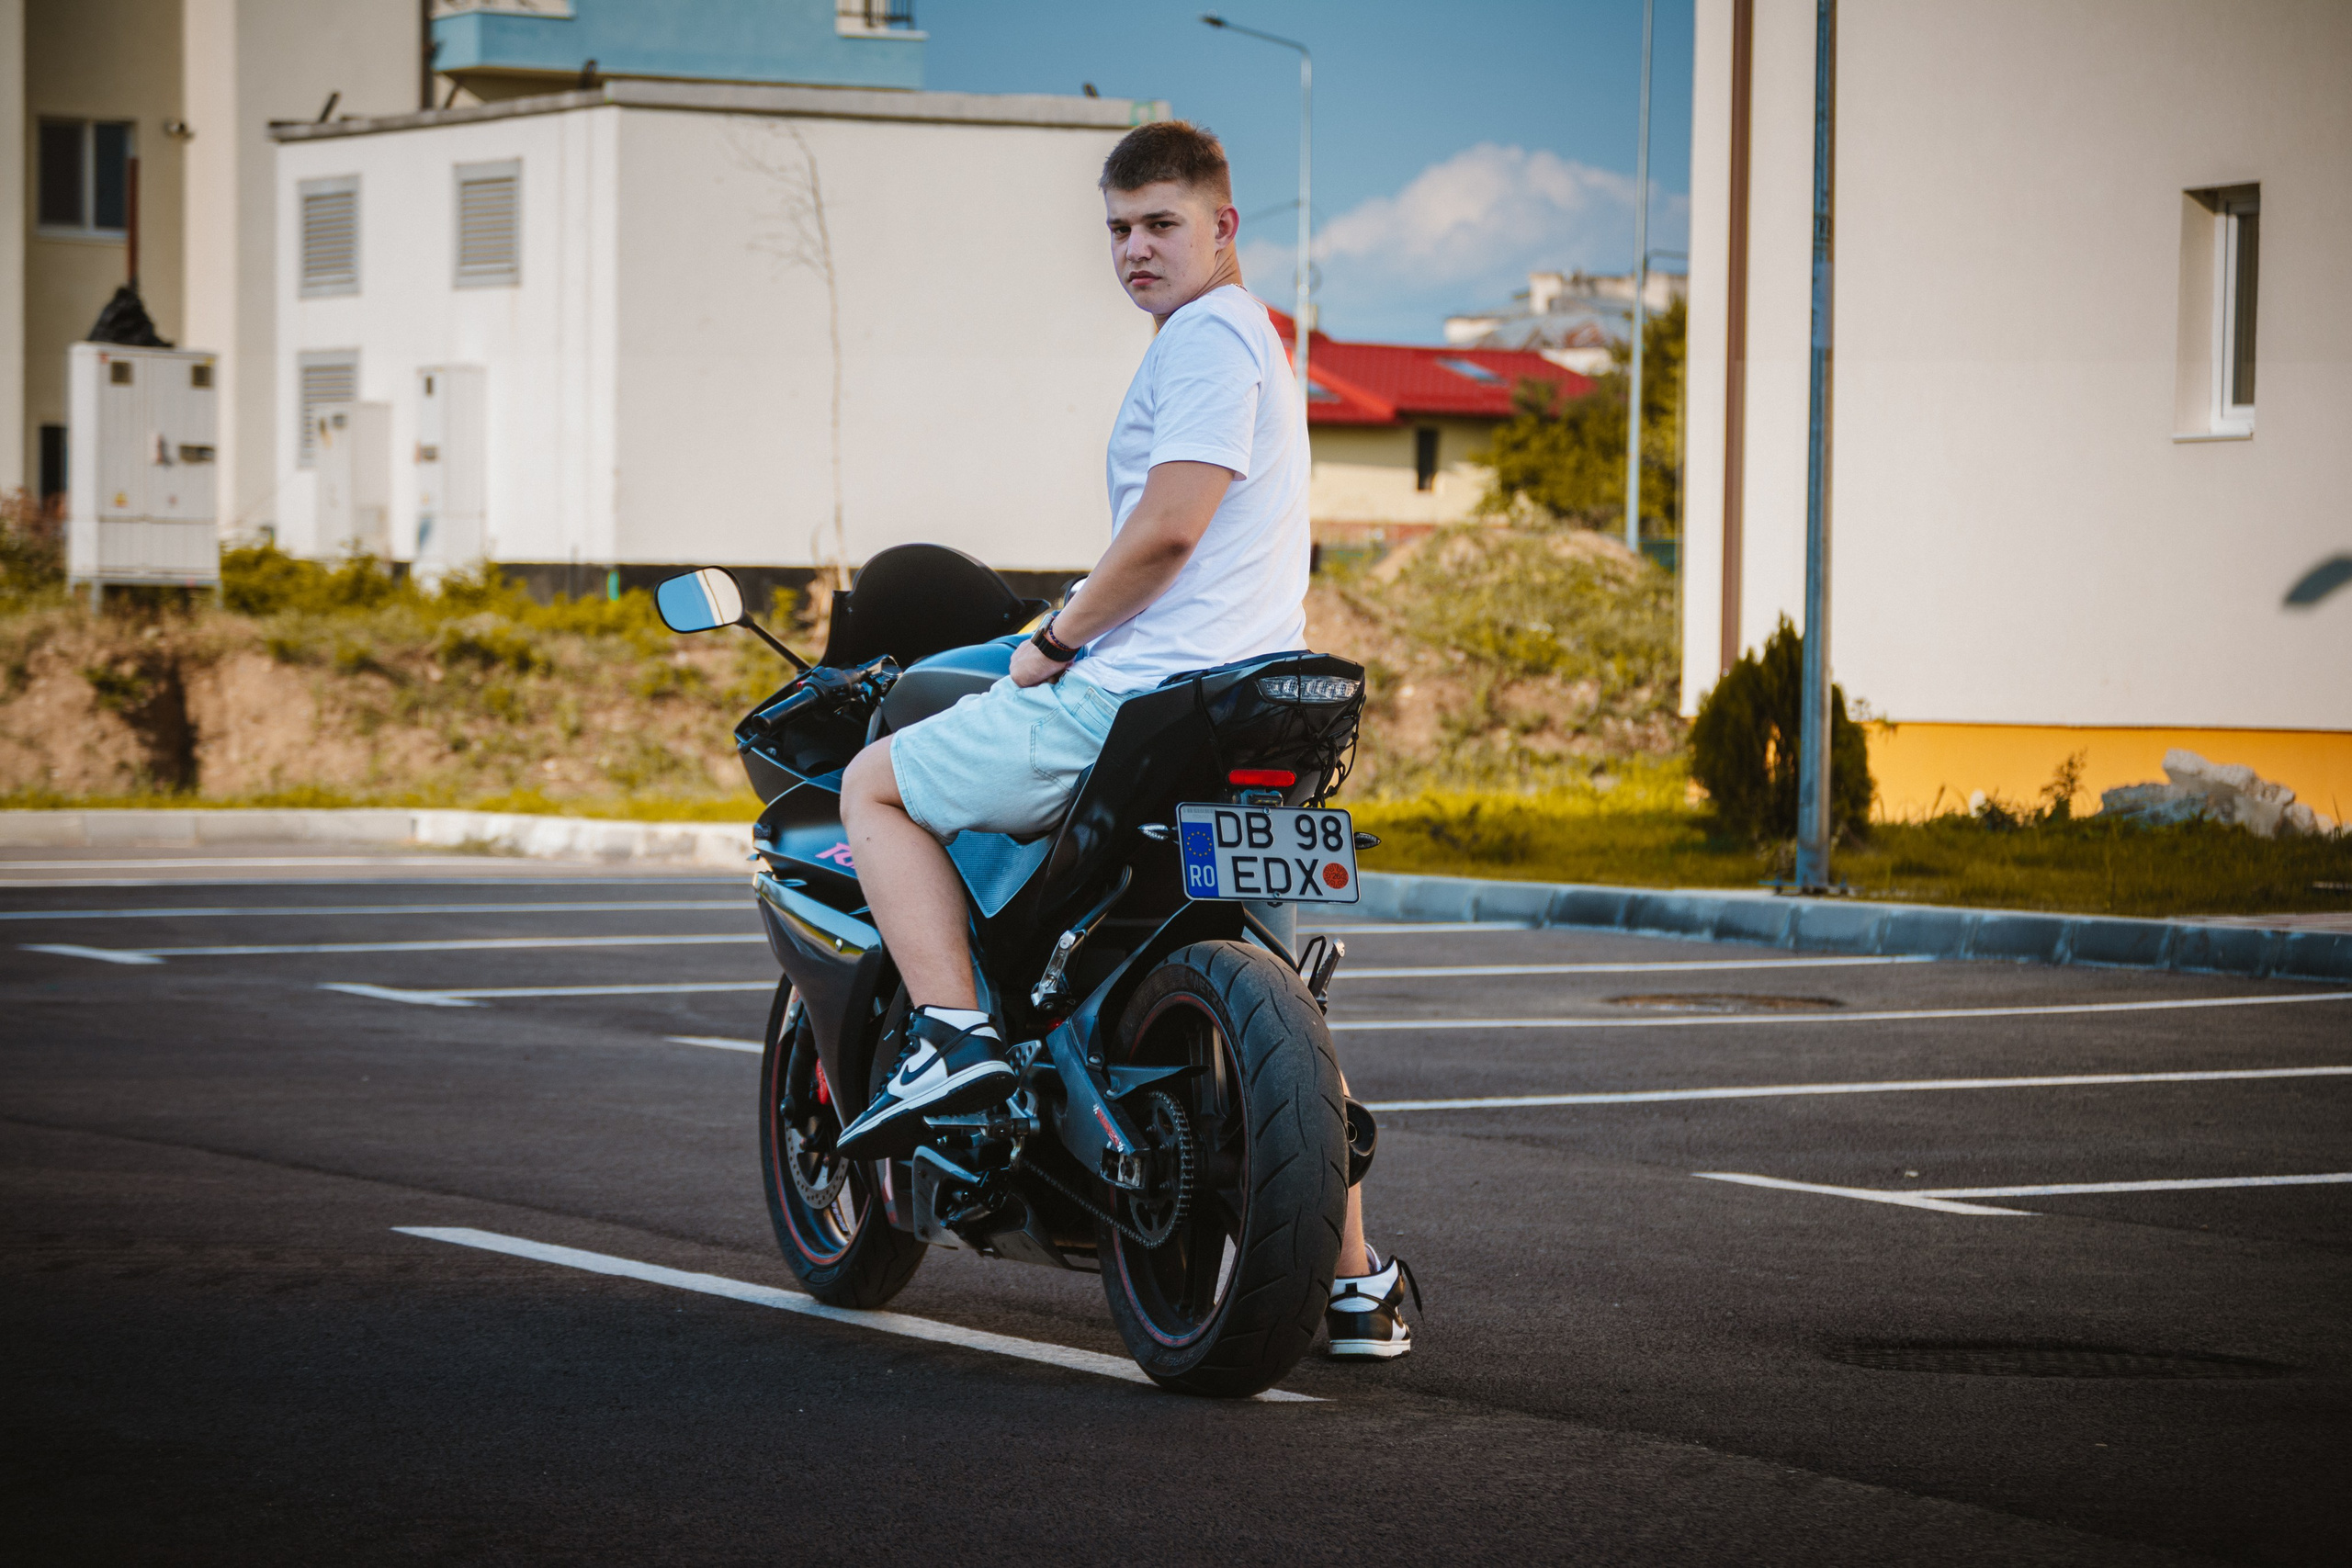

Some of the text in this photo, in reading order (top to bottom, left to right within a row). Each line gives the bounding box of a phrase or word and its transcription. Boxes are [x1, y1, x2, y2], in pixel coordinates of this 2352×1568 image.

[1215, 810, 1344, 852] DB 98
[1189, 864, 1216, 887] RO
[1231, 856, 1323, 896] EDX
